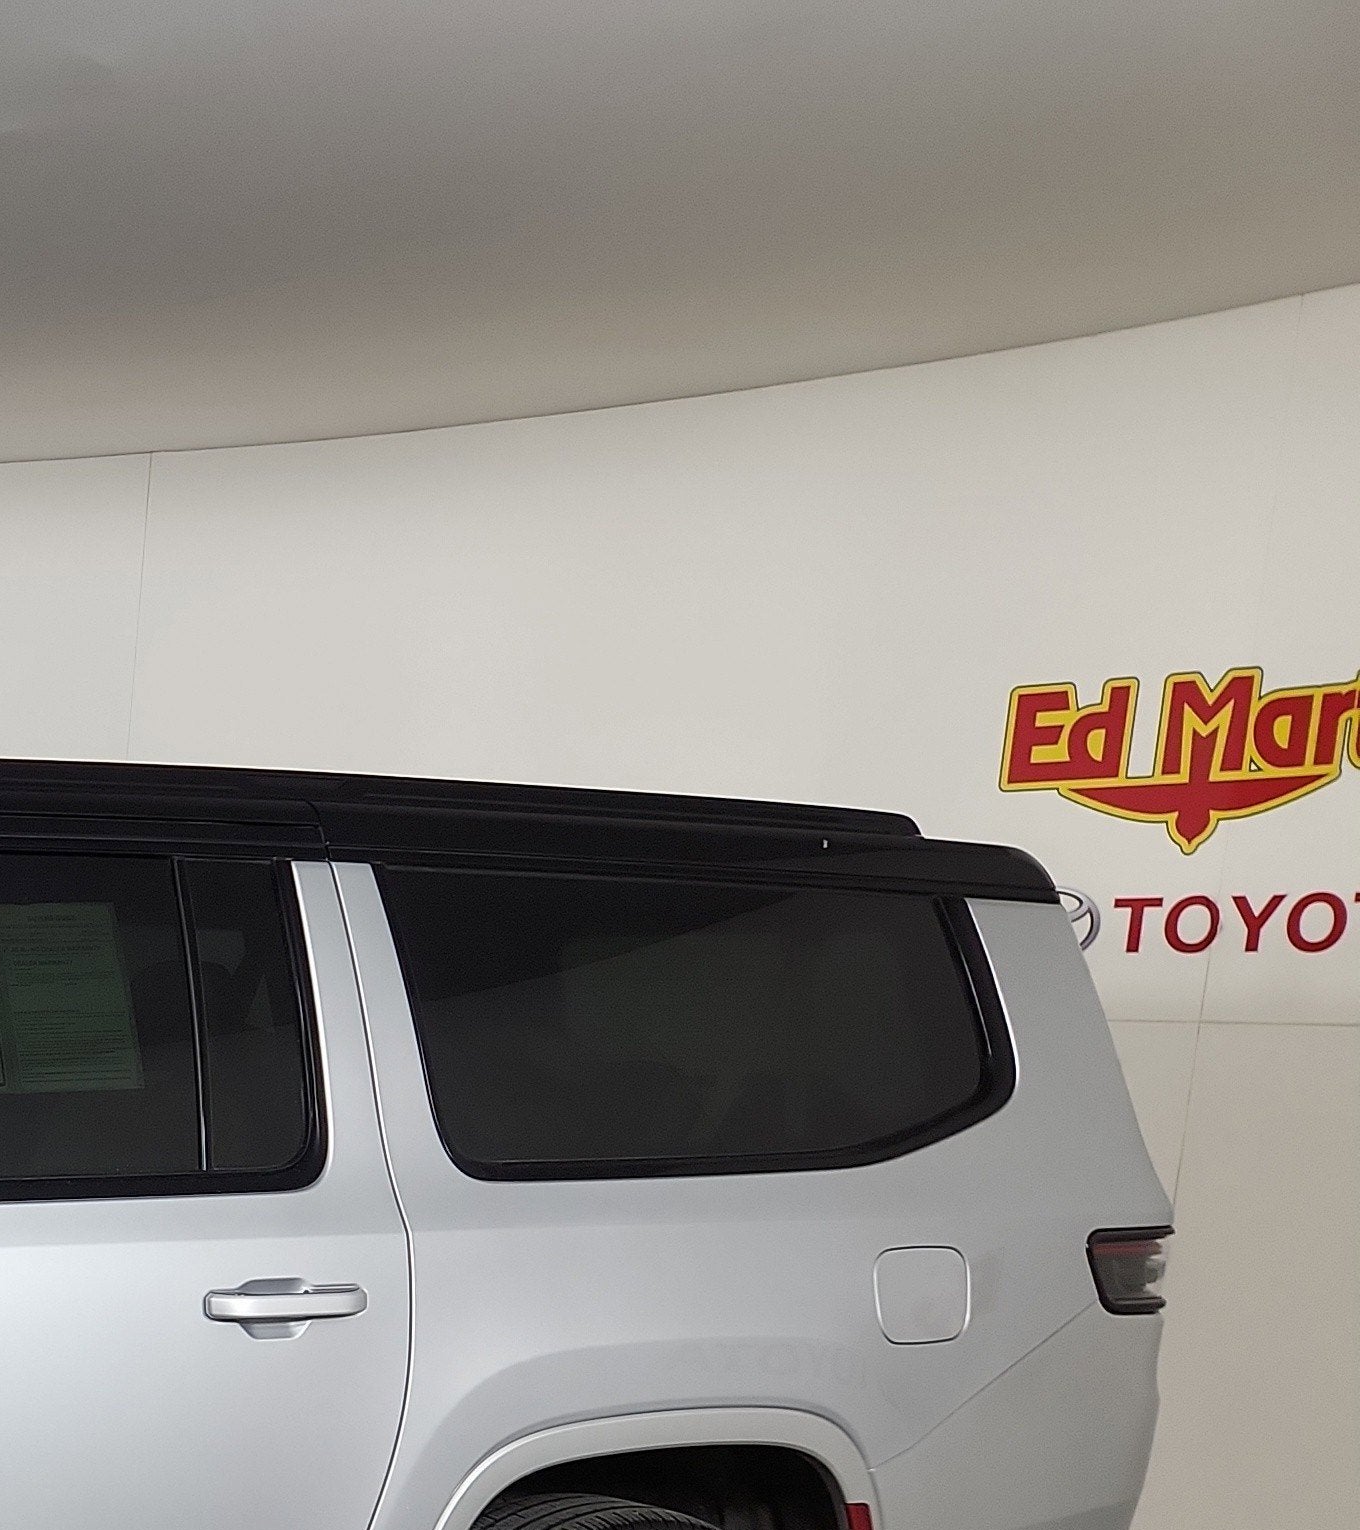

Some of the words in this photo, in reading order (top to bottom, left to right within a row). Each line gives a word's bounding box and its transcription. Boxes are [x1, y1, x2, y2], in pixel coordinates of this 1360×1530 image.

[1003, 682, 1135, 786] Ed
[1158, 671, 1360, 772] Mar
[1114, 892, 1360, 953] TOYO
